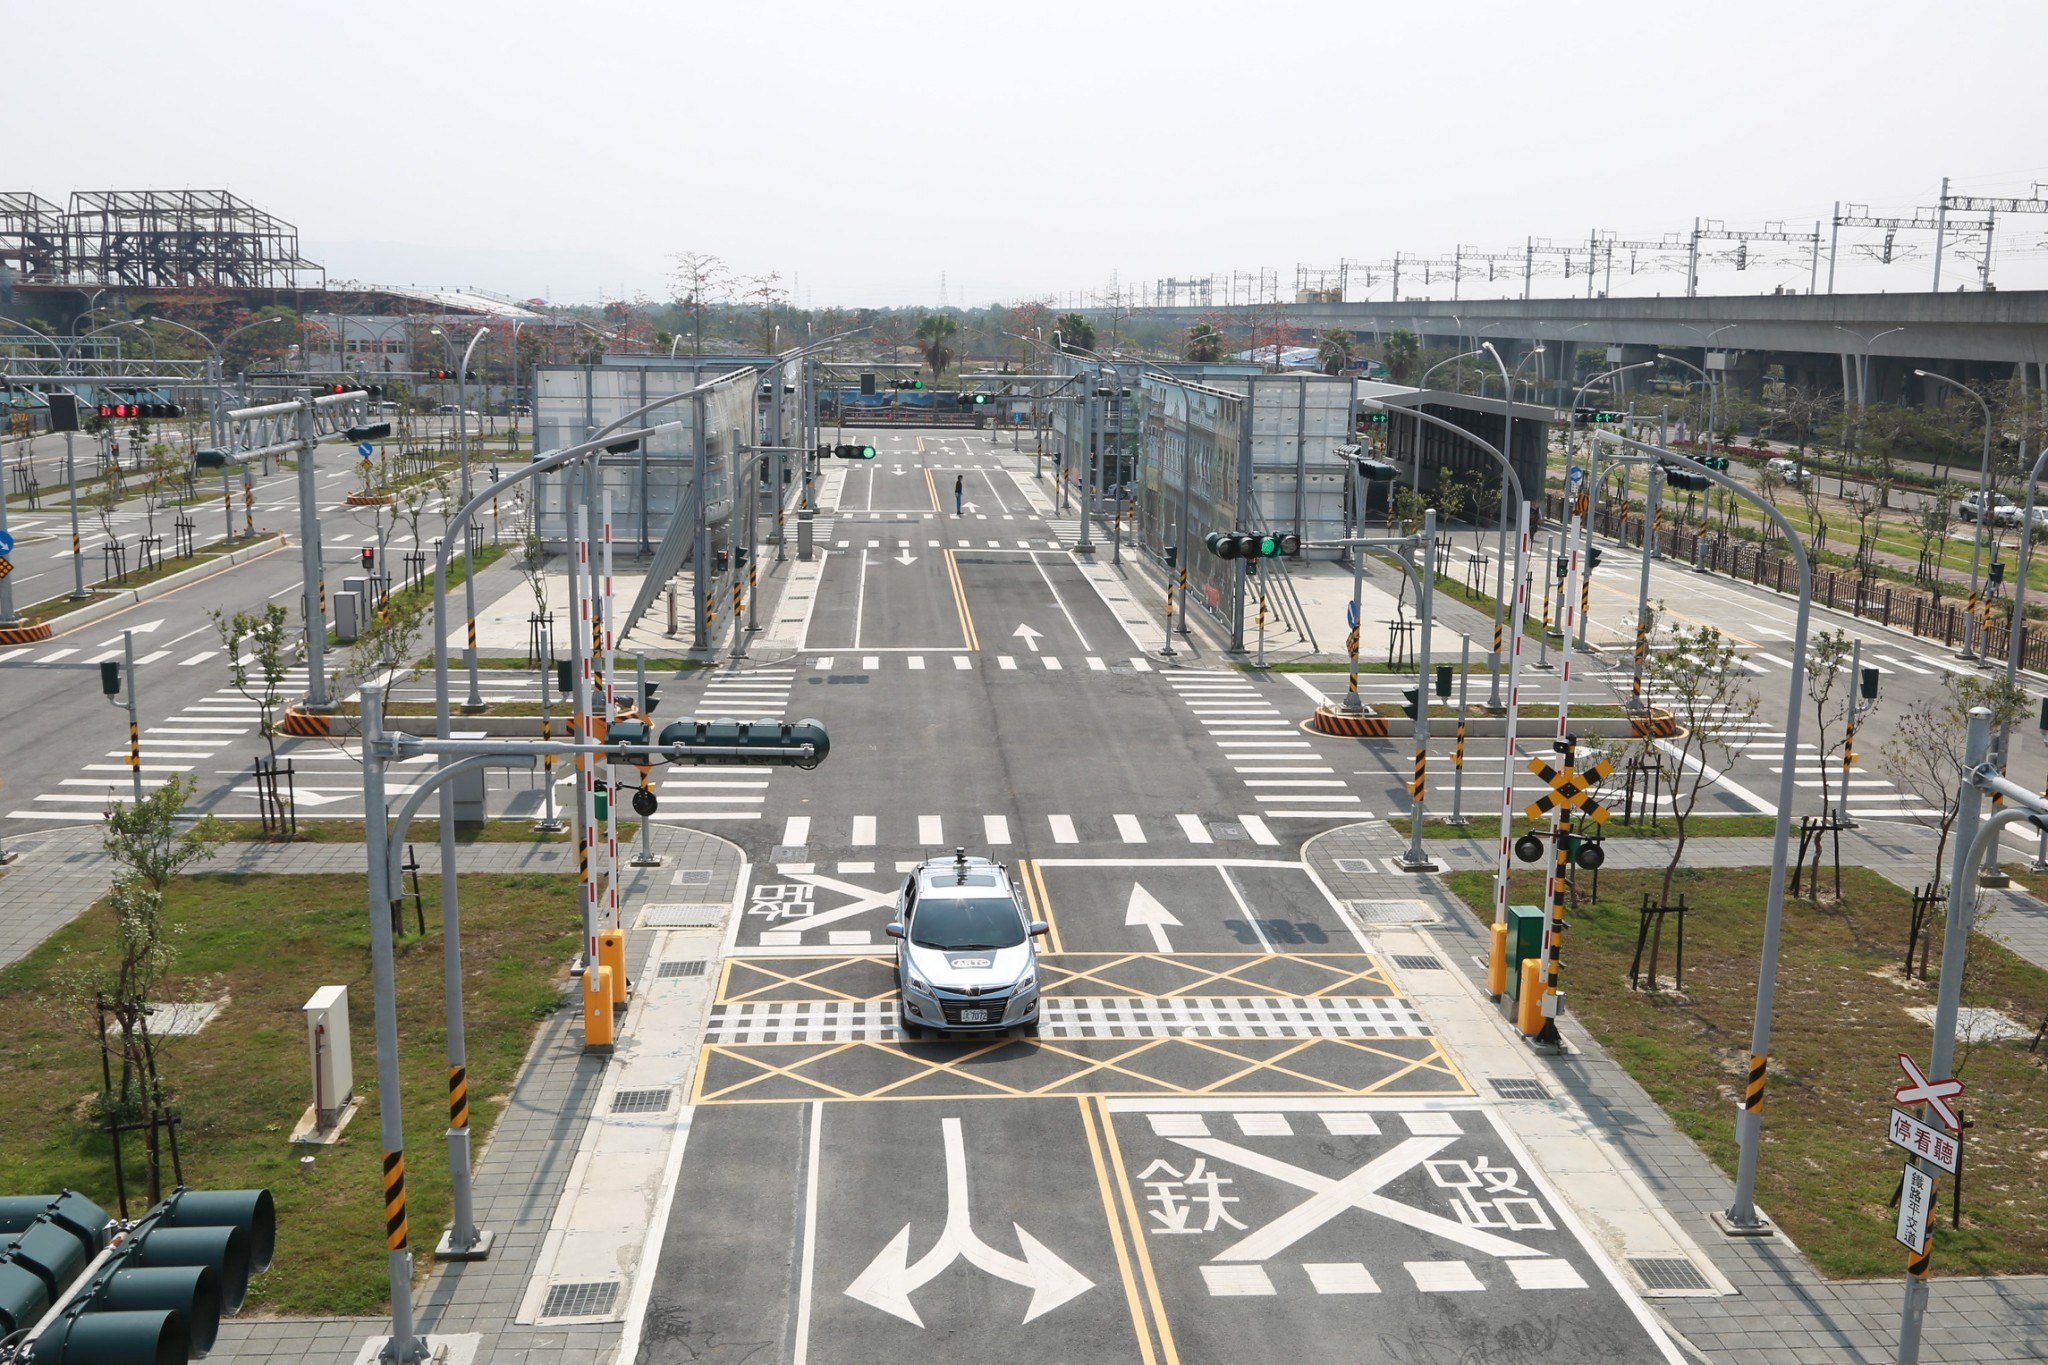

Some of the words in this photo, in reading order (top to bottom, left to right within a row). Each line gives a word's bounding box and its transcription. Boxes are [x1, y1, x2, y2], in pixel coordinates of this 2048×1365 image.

[1894, 1116, 1953, 1165] 停看聽
[1422, 1156, 1557, 1231] 路
[1903, 1171, 1925, 1248] 鐵路平交道
